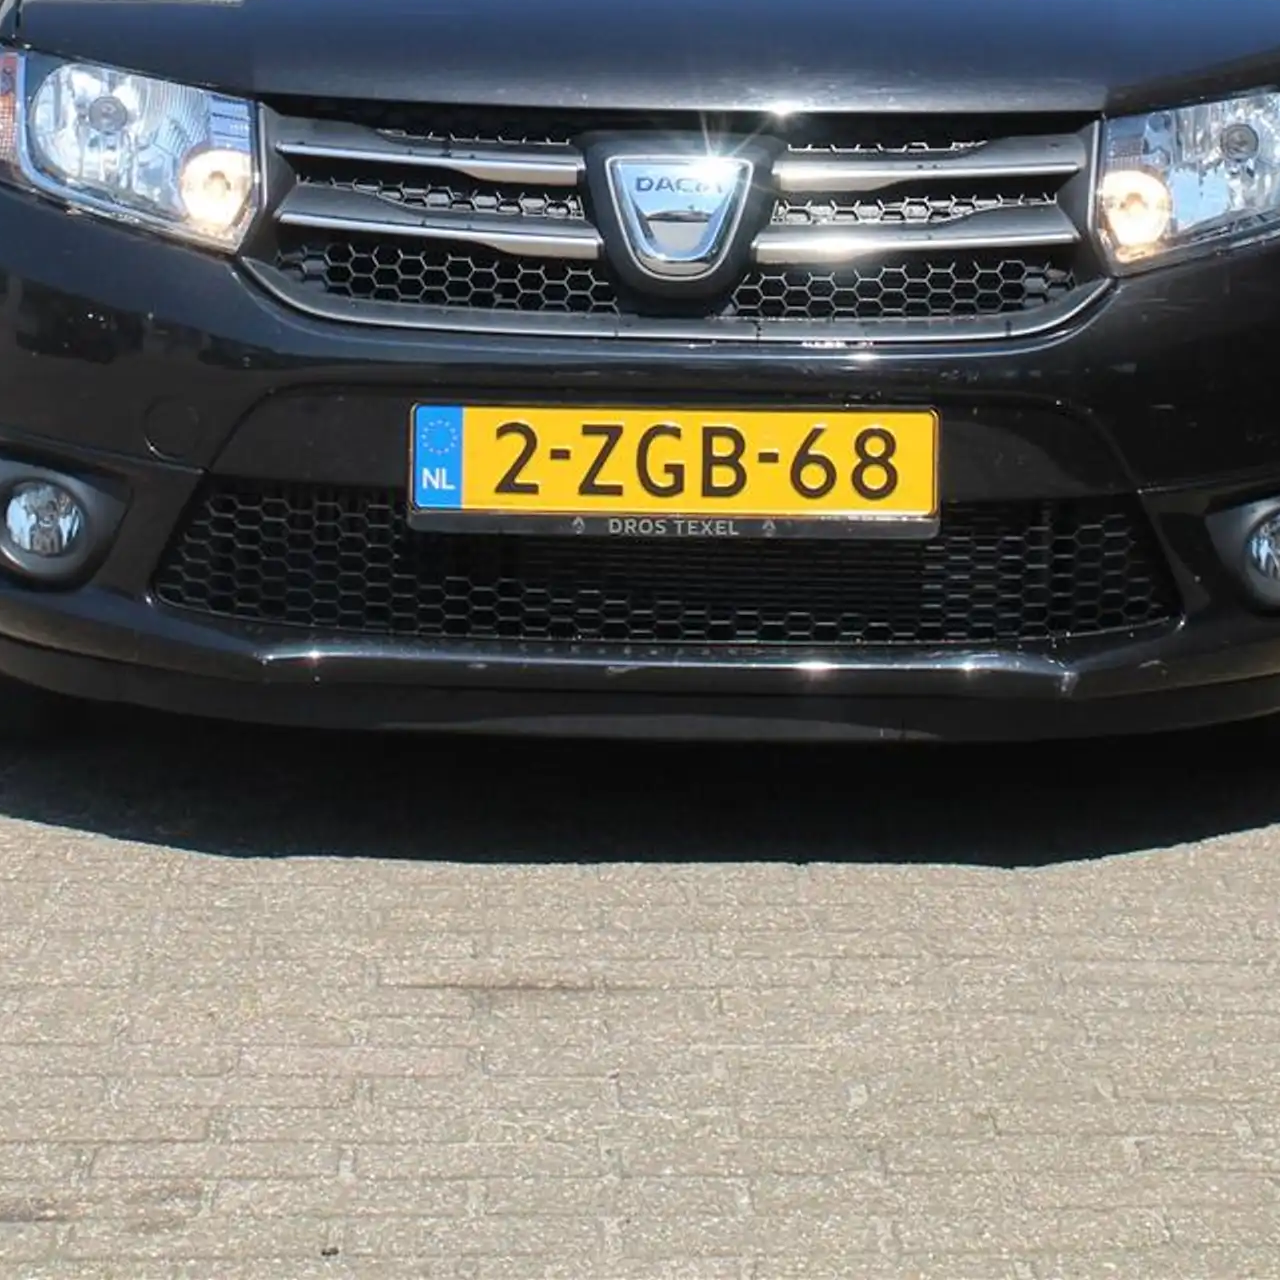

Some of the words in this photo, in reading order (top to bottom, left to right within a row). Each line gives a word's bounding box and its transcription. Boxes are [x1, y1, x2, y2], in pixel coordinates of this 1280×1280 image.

[495, 422, 898, 500] 2-ZGB-68
[422, 467, 455, 490] NL
[609, 518, 667, 534] DROS
[674, 519, 740, 535] TEXEL
